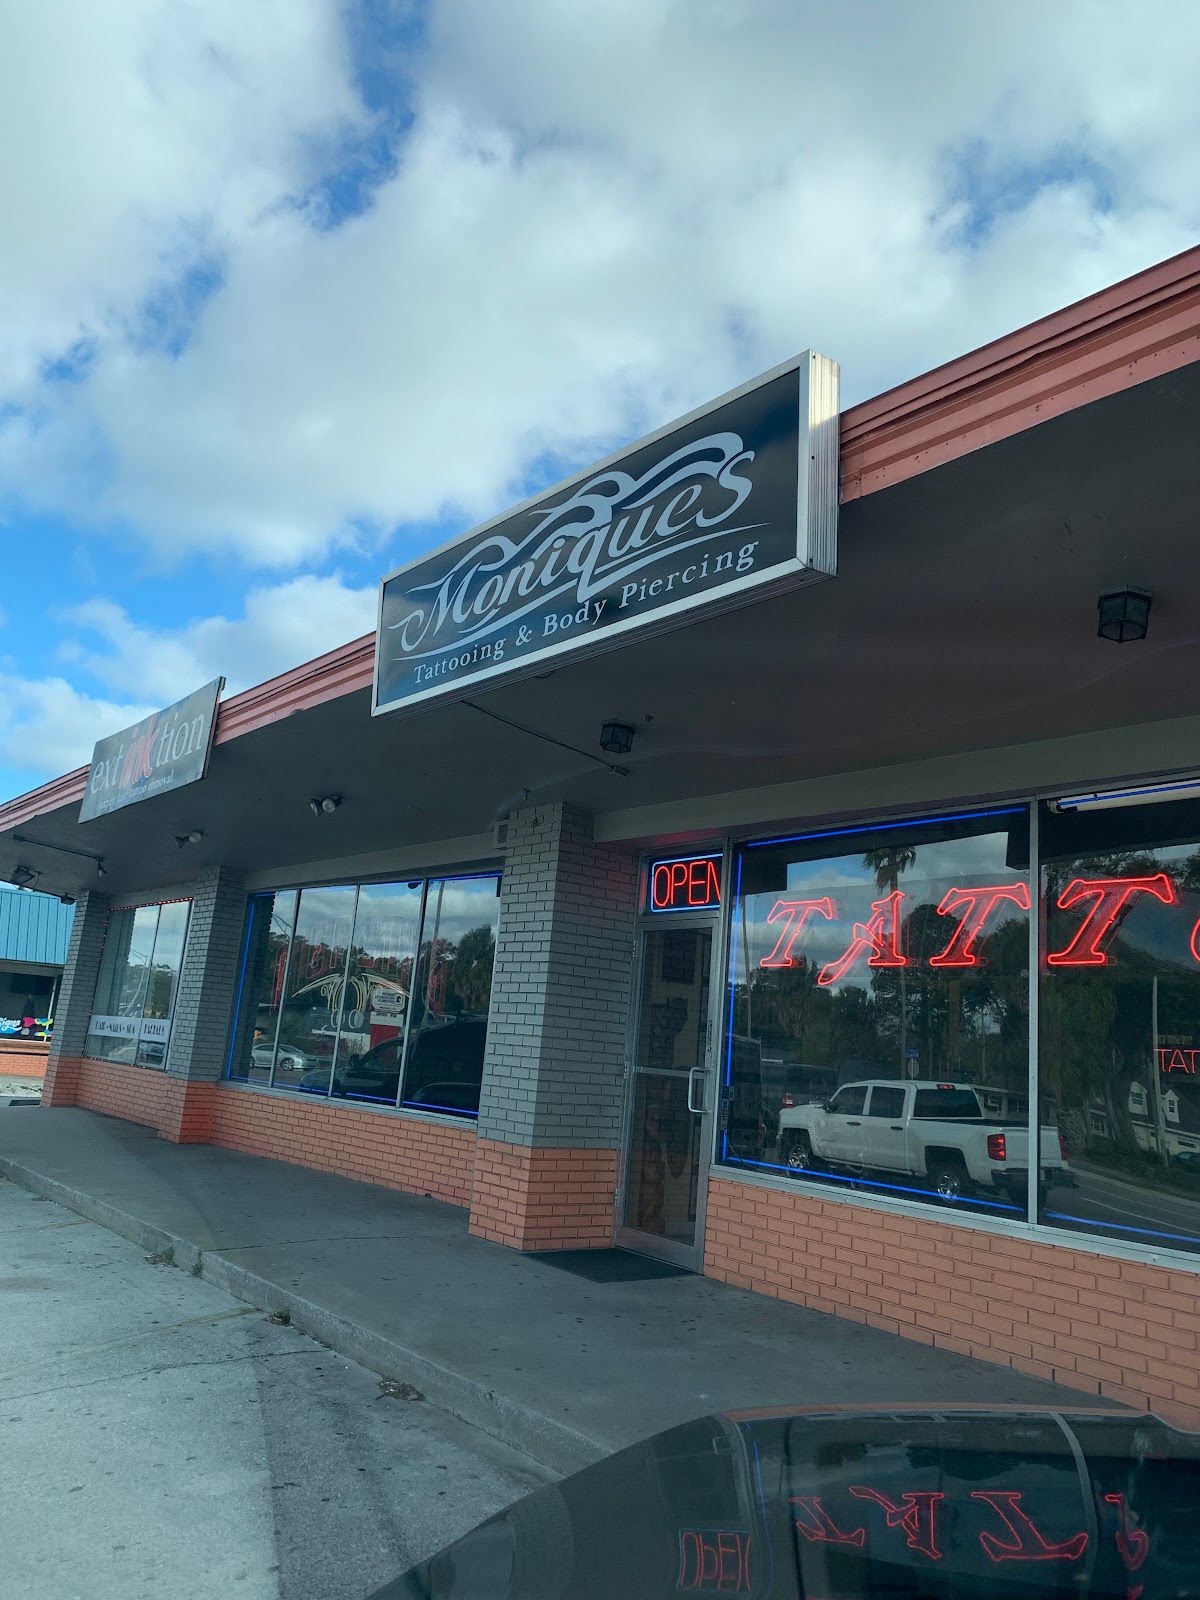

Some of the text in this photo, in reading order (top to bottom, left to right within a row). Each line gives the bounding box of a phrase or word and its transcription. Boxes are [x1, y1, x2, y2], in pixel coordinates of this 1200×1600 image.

[387, 450, 755, 652] Moniques
[413, 540, 759, 684] Tattooing & Body Piercing
[654, 861, 721, 907] OPEN
[760, 874, 1200, 986] TATT
